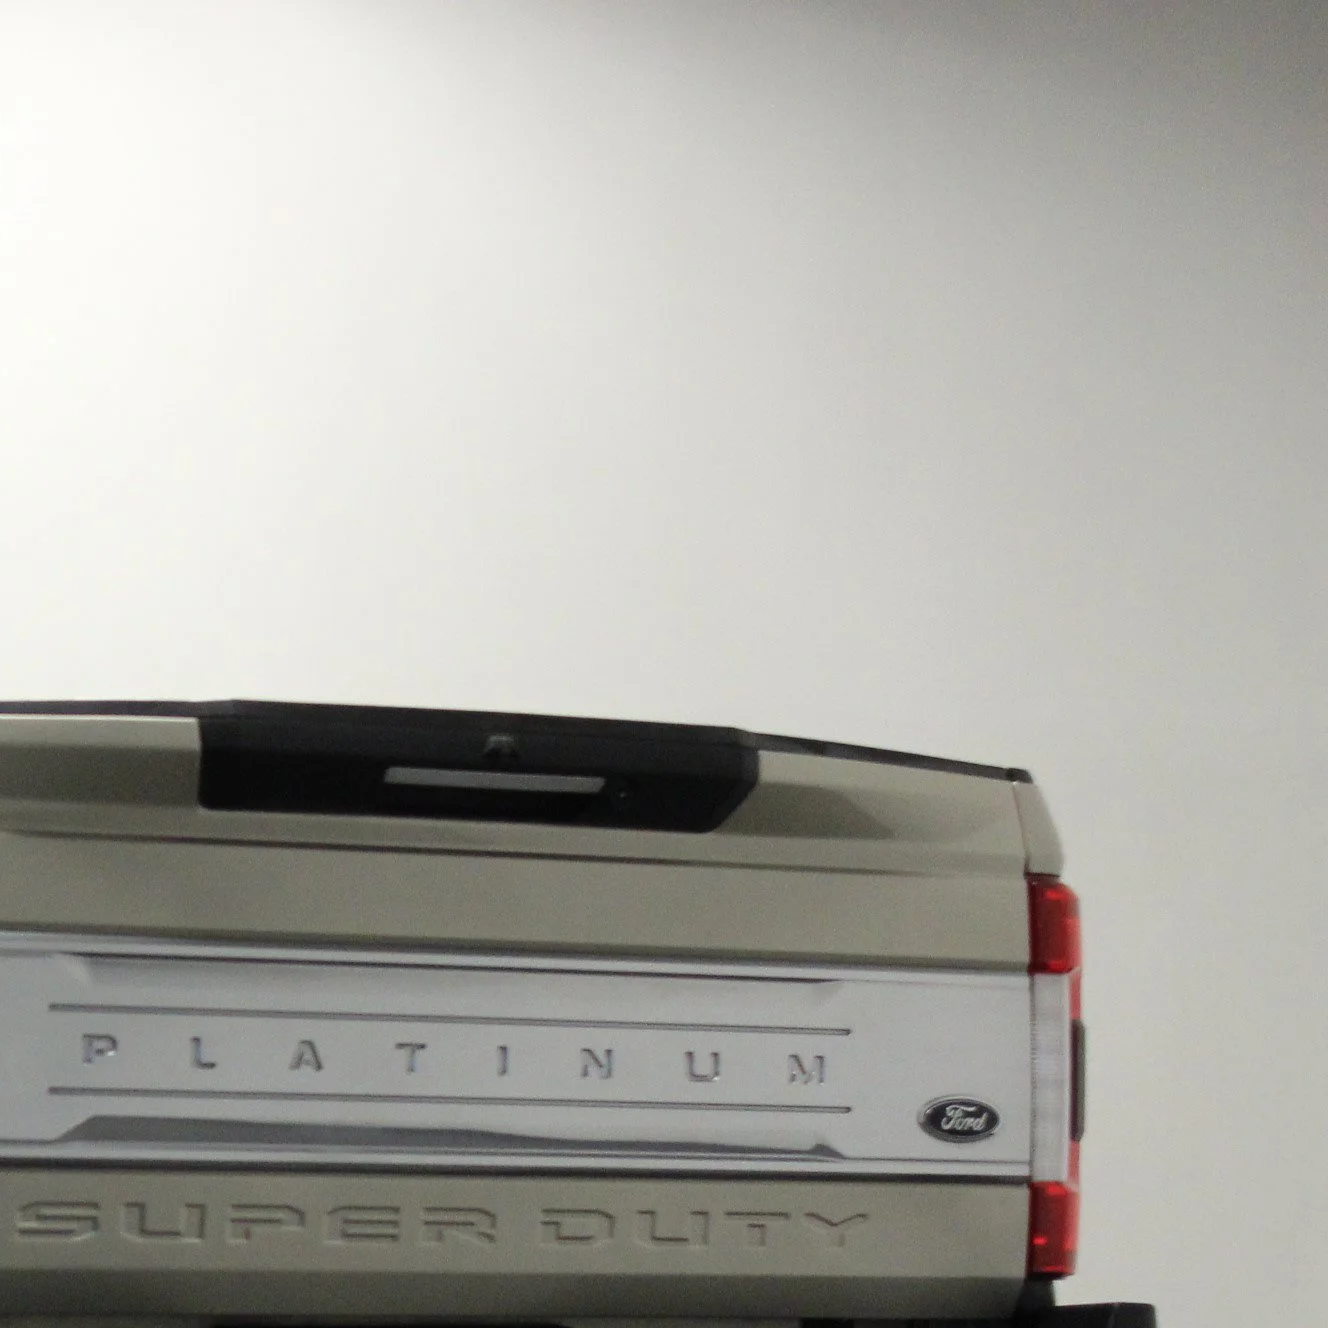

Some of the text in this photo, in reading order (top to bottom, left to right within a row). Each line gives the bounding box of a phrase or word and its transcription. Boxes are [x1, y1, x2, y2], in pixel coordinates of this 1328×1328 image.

[80, 1033, 828, 1085] PLATINUM
[15, 1201, 870, 1250] SUPER DUTY
